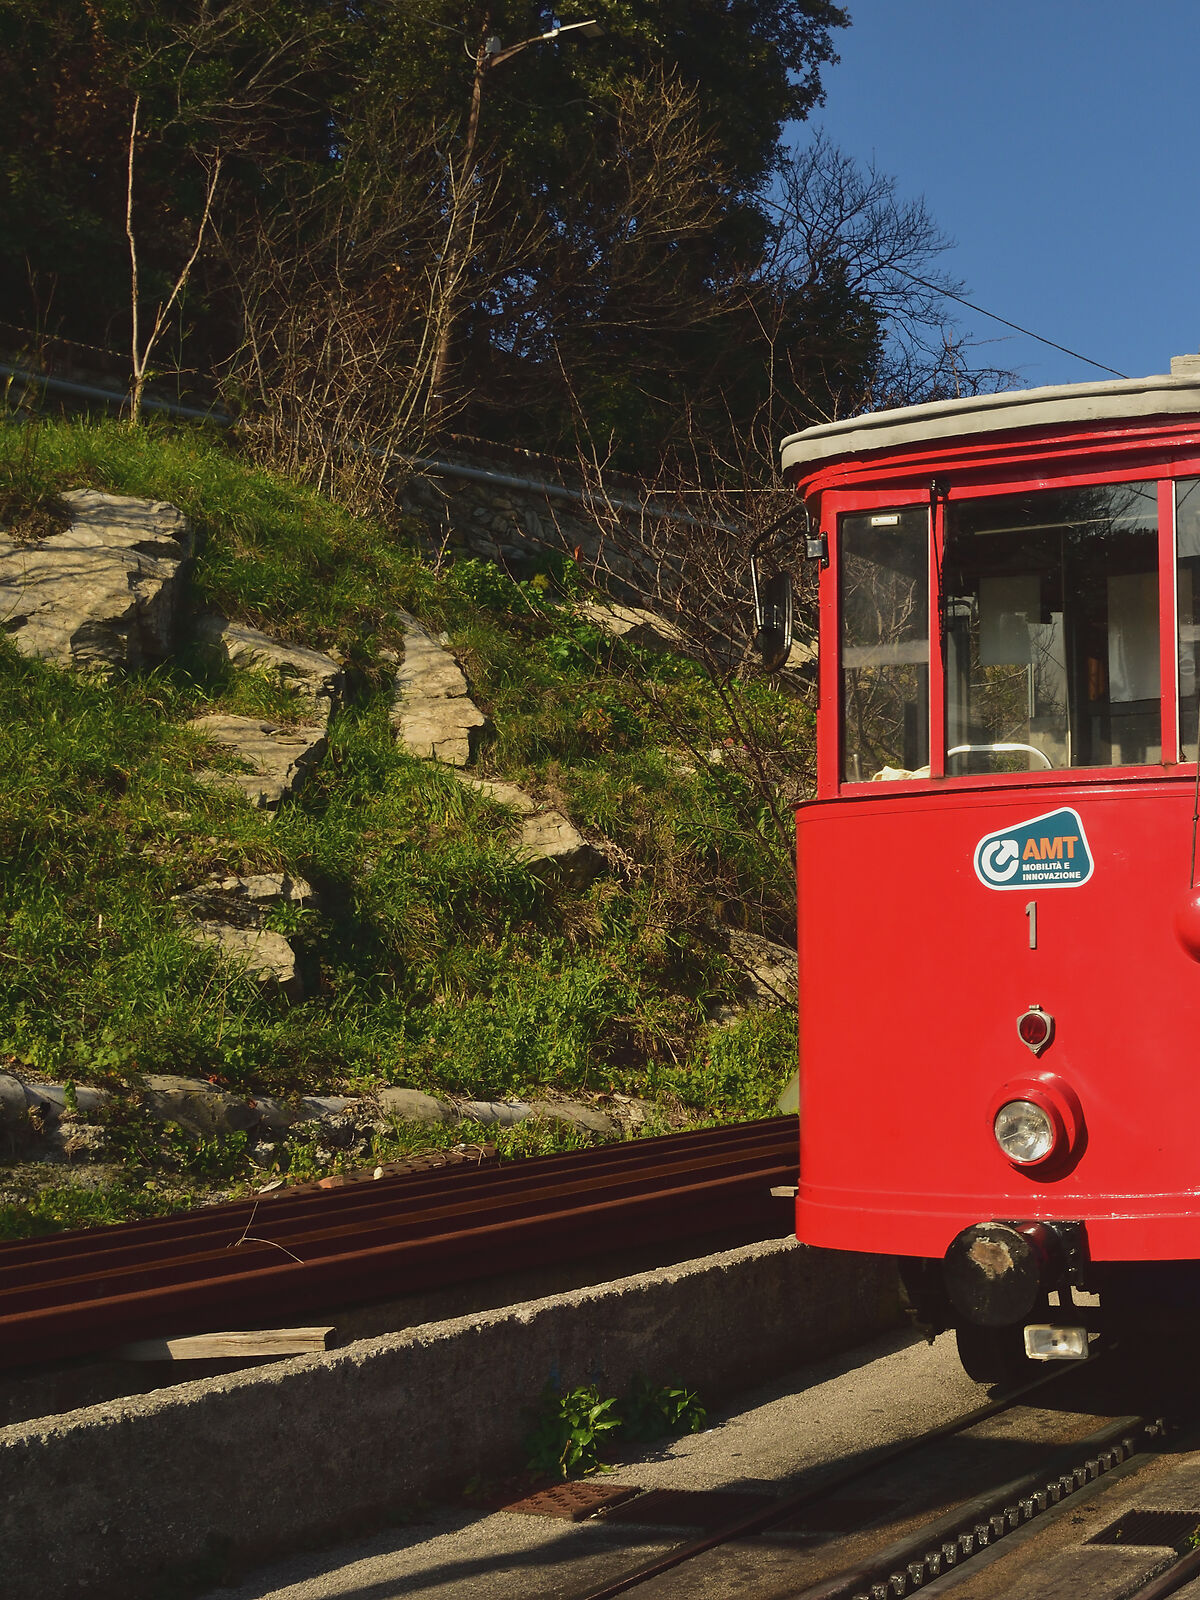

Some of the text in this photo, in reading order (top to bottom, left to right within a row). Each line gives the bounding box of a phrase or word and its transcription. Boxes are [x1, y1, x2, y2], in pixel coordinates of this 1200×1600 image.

[1022, 836, 1079, 860] AMT
[1022, 861, 1062, 871] MOBILITÀ
[1022, 871, 1081, 880] INNOVAZIONE
[1025, 901, 1037, 949] 1
